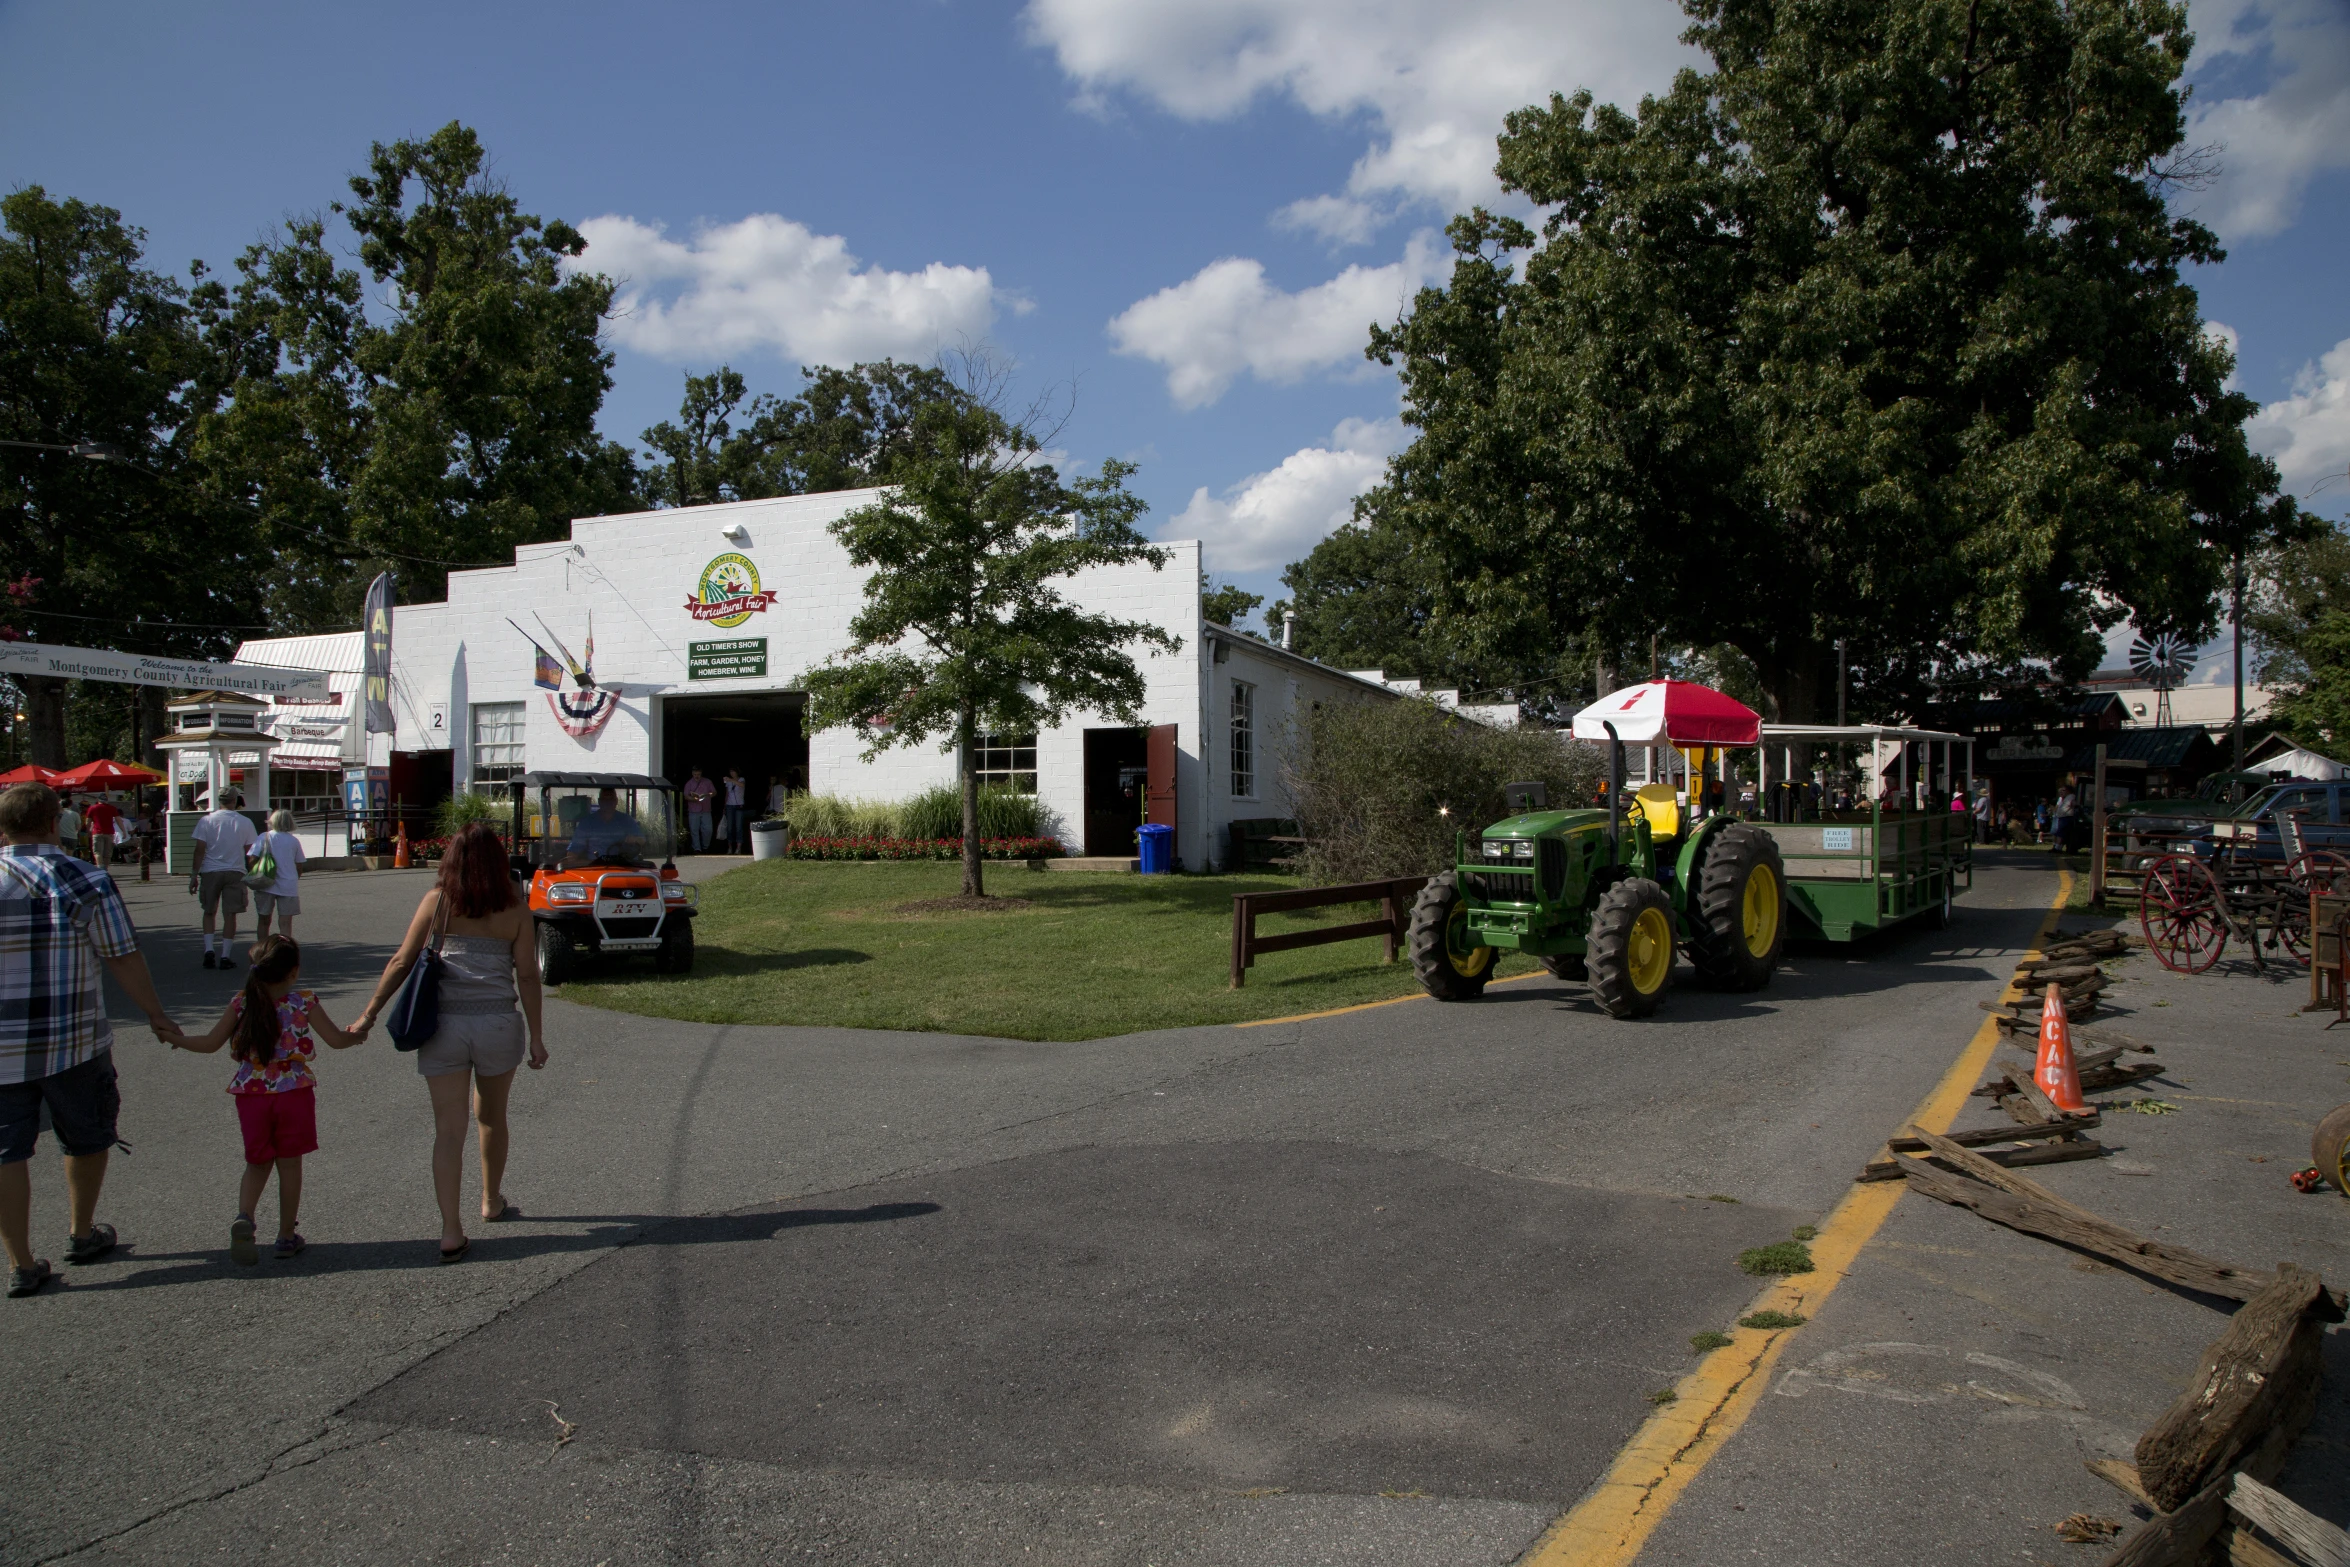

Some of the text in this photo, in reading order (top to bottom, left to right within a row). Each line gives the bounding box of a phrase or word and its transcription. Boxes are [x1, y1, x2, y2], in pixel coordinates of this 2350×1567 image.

[700, 555, 758, 591] MONTGOMERY COUNTY
[694, 596, 763, 620] Agricultural Fair
[696, 640, 759, 652] OLD TIMER'S SHOW
[20, 655, 39, 663] FAIR
[690, 655, 766, 667] FARM, GARDEN, HONEY
[140, 658, 214, 675] Welcome to the
[698, 666, 757, 676] HOMEBREW, WINE
[48, 659, 287, 692] Montgomery County Agricultural Fair
[307, 682, 322, 690] FAIR
[184, 717, 211, 725] INFORMATION
[219, 717, 253, 725] INFORMATION
[434, 713, 442, 728] 2
[290, 727, 325, 737] Barbeque
[351, 783, 367, 841] ATM
[611, 903, 648, 914] RTV
